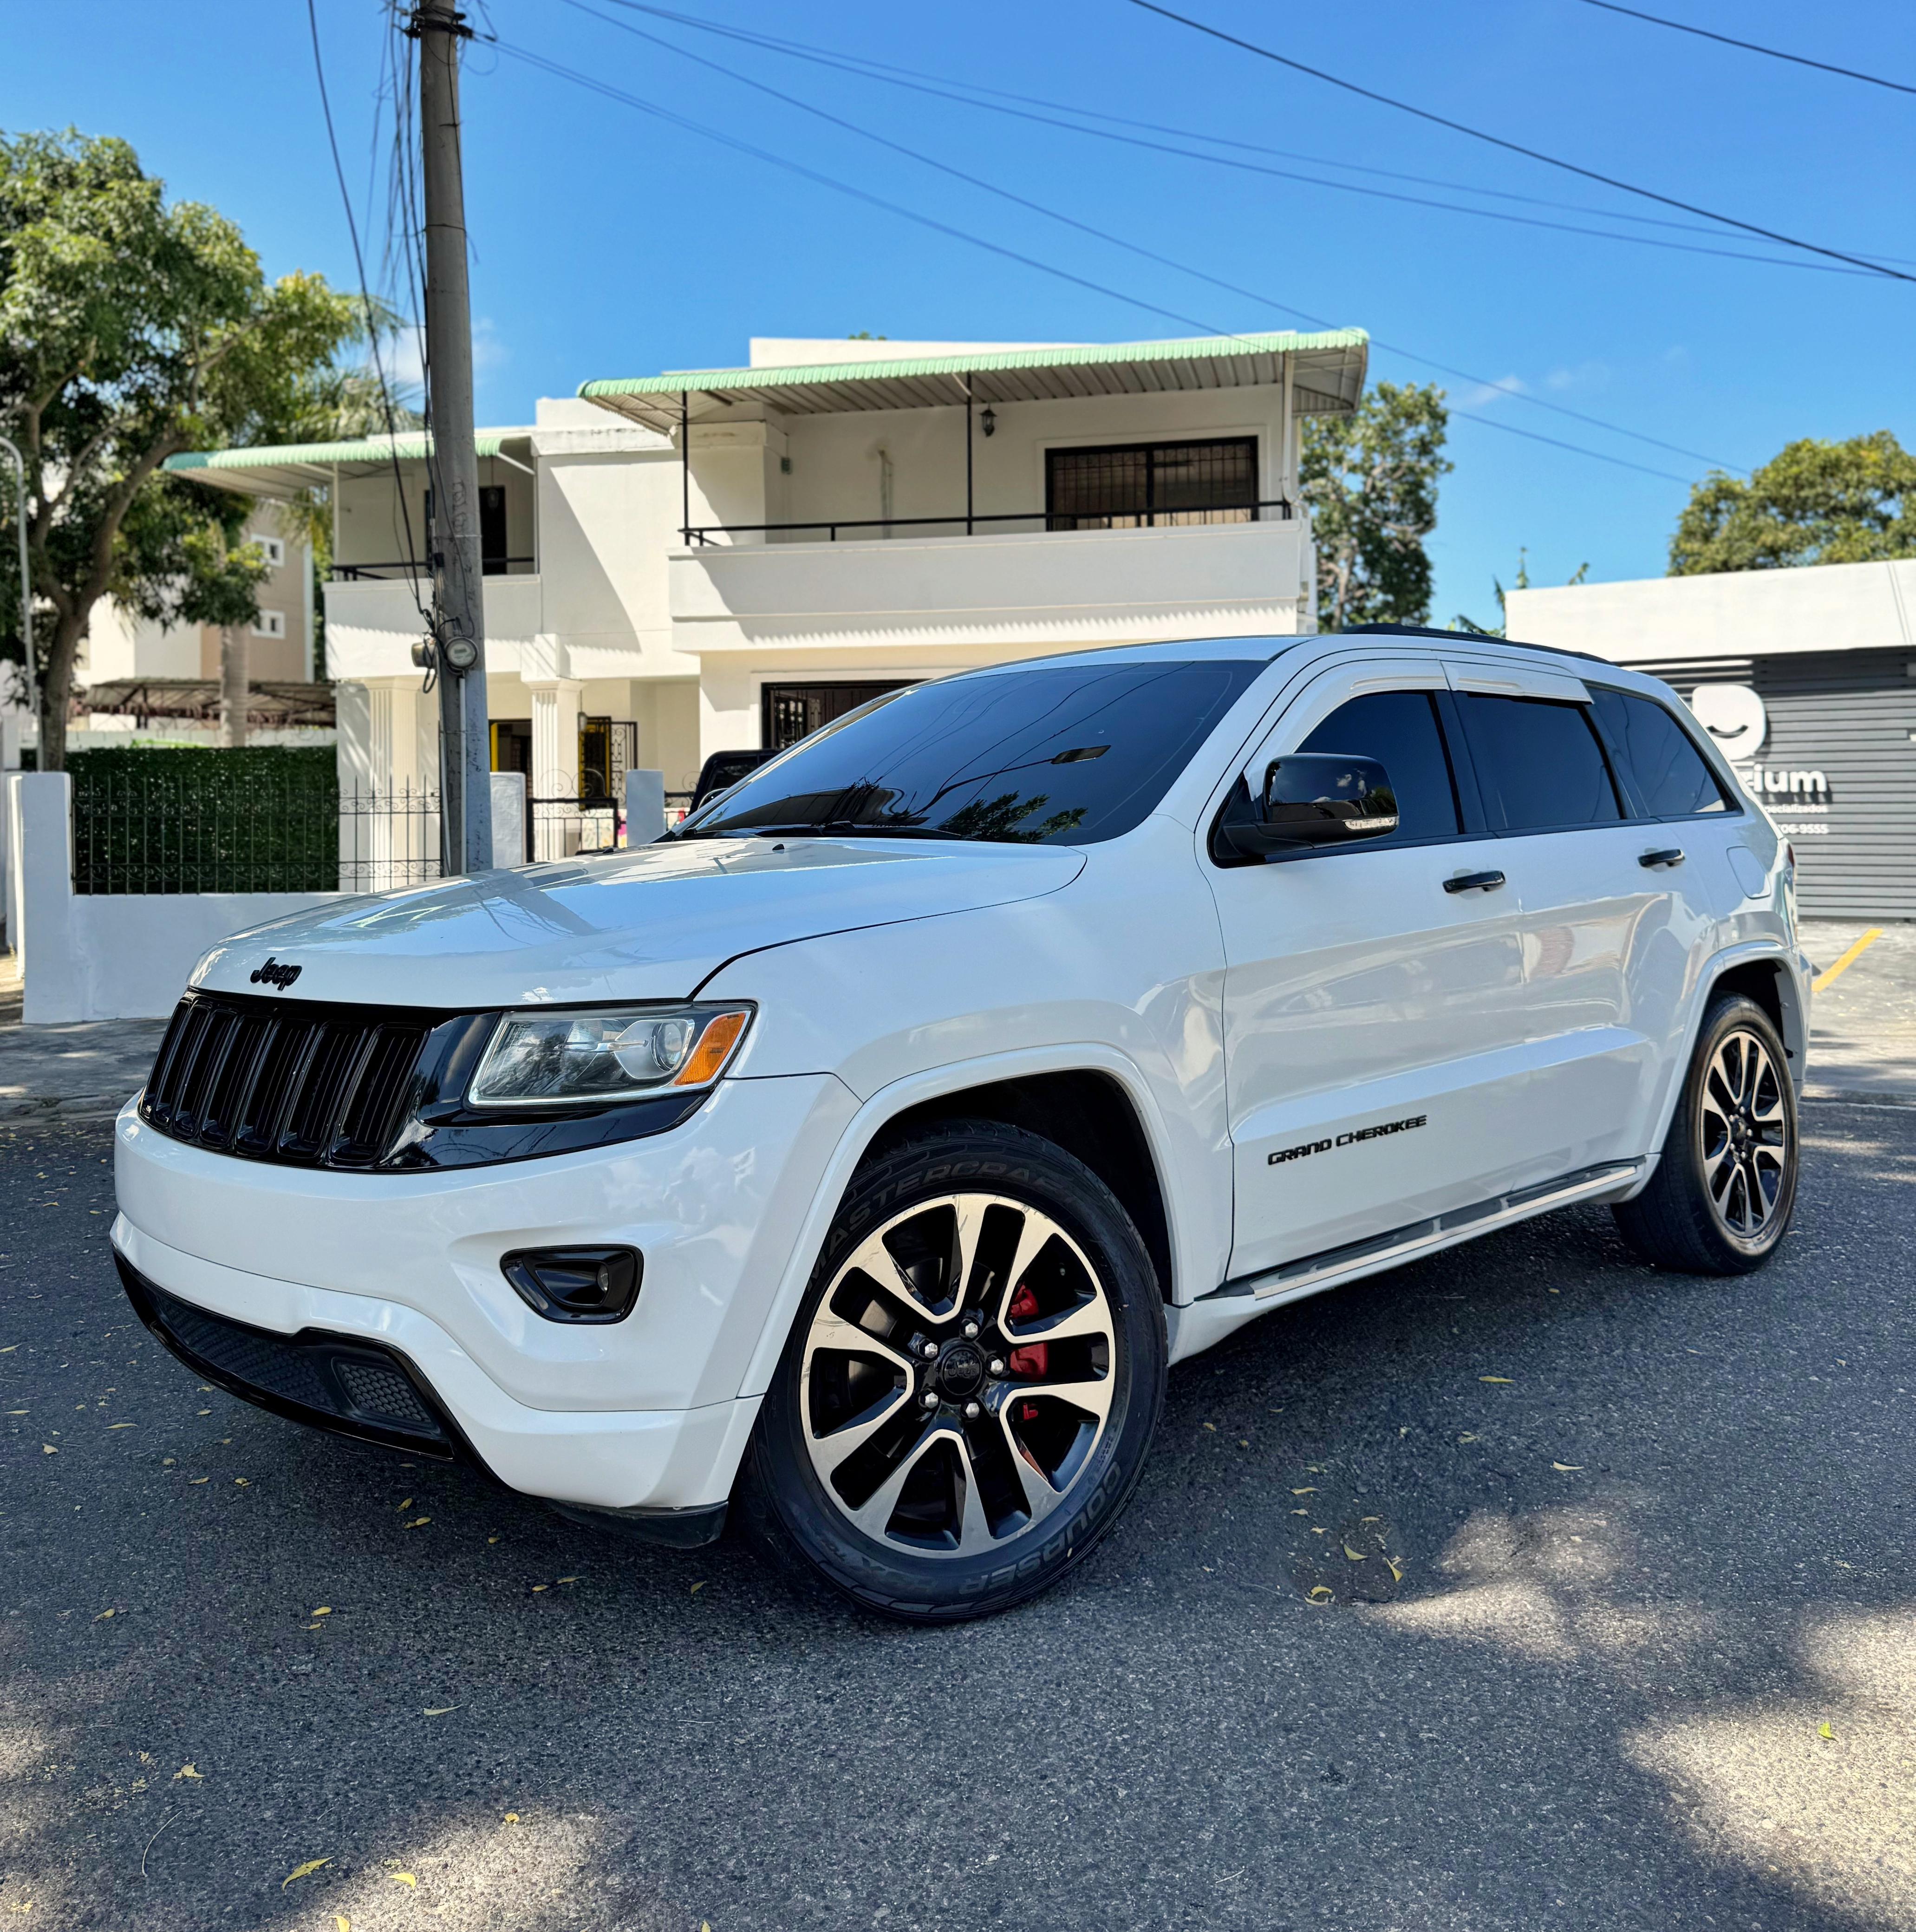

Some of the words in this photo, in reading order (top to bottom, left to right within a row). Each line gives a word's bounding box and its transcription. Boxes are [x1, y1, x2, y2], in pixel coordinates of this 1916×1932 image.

[1778, 824, 1829, 834] 06-9555
[250, 957, 302, 991] Jeep
[1267, 1138, 1332, 1165] GRAND
[1336, 1115, 1427, 1147] CHEROKEE
[958, 1461, 1121, 1594] COURSER
